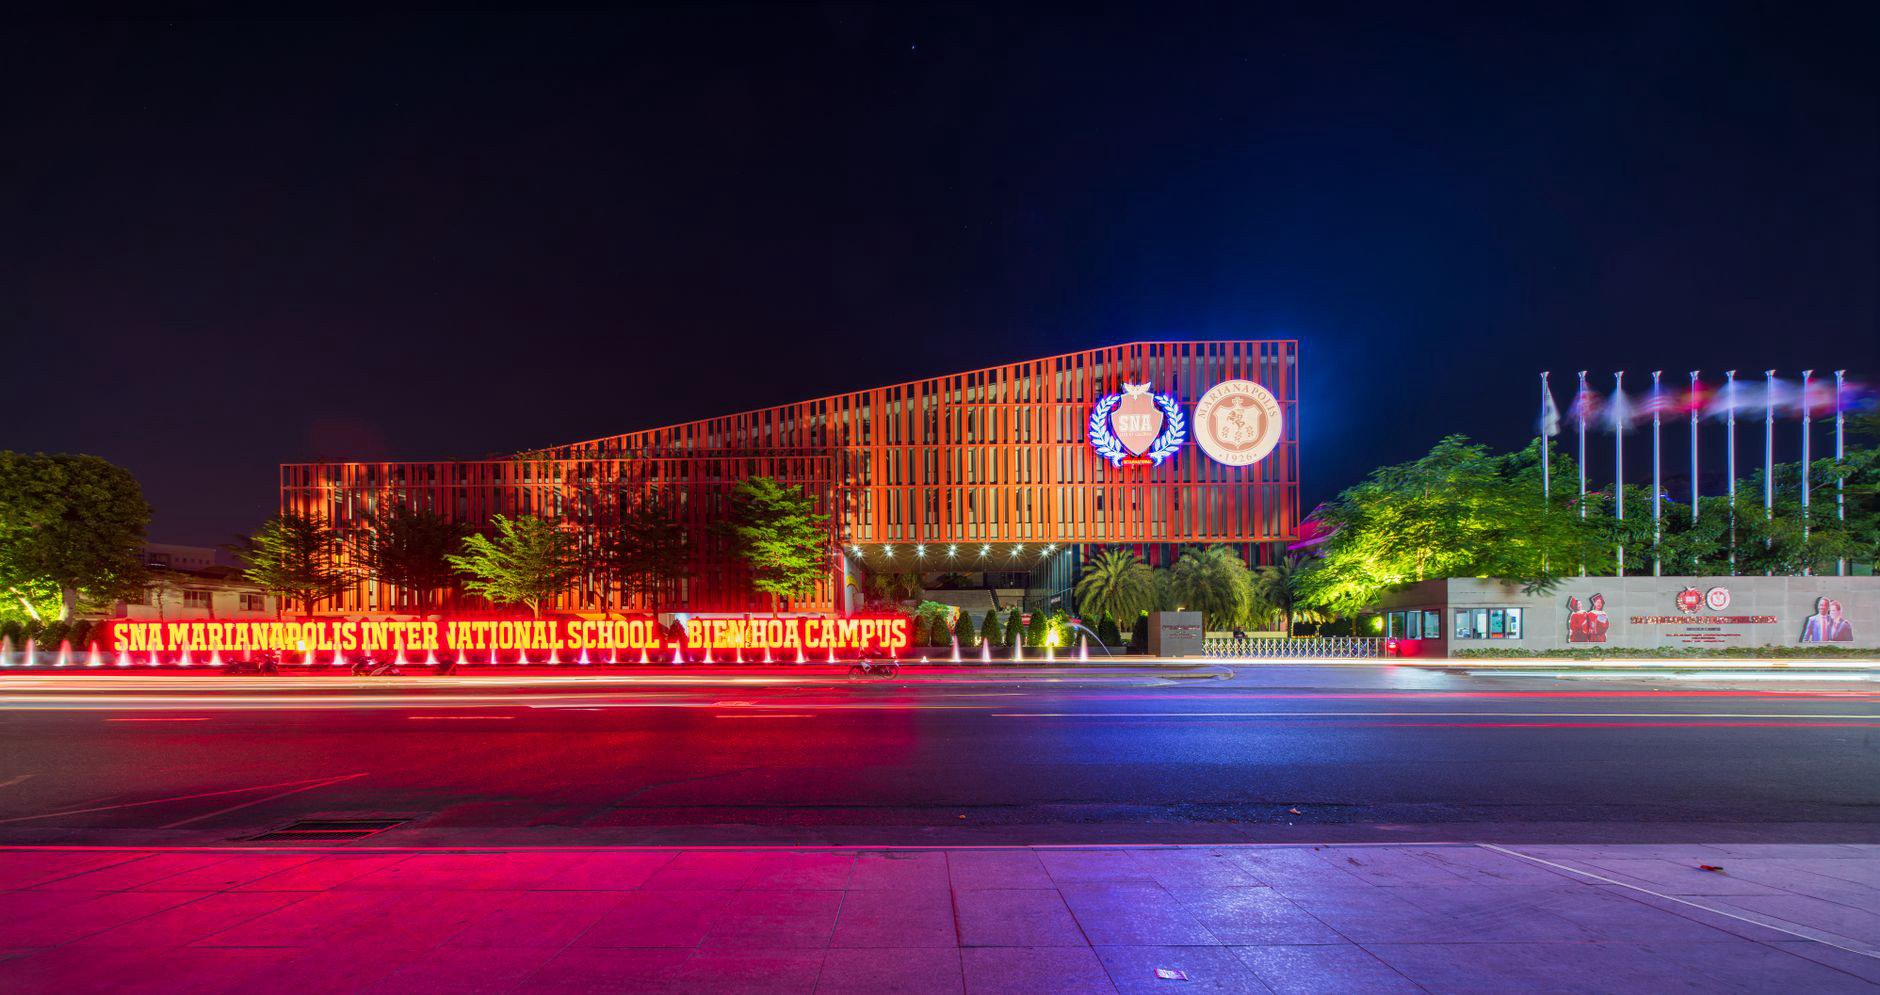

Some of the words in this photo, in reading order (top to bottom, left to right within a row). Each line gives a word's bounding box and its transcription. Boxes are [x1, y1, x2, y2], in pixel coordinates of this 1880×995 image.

[1198, 383, 1278, 419] MARIANAPOLIS
[1119, 415, 1152, 431] SNA
[113, 622, 165, 651] SNA
[167, 621, 357, 651] MARIANAPOLIS
[567, 620, 660, 649] SCHOOL
[804, 618, 907, 648] CAMPUS
